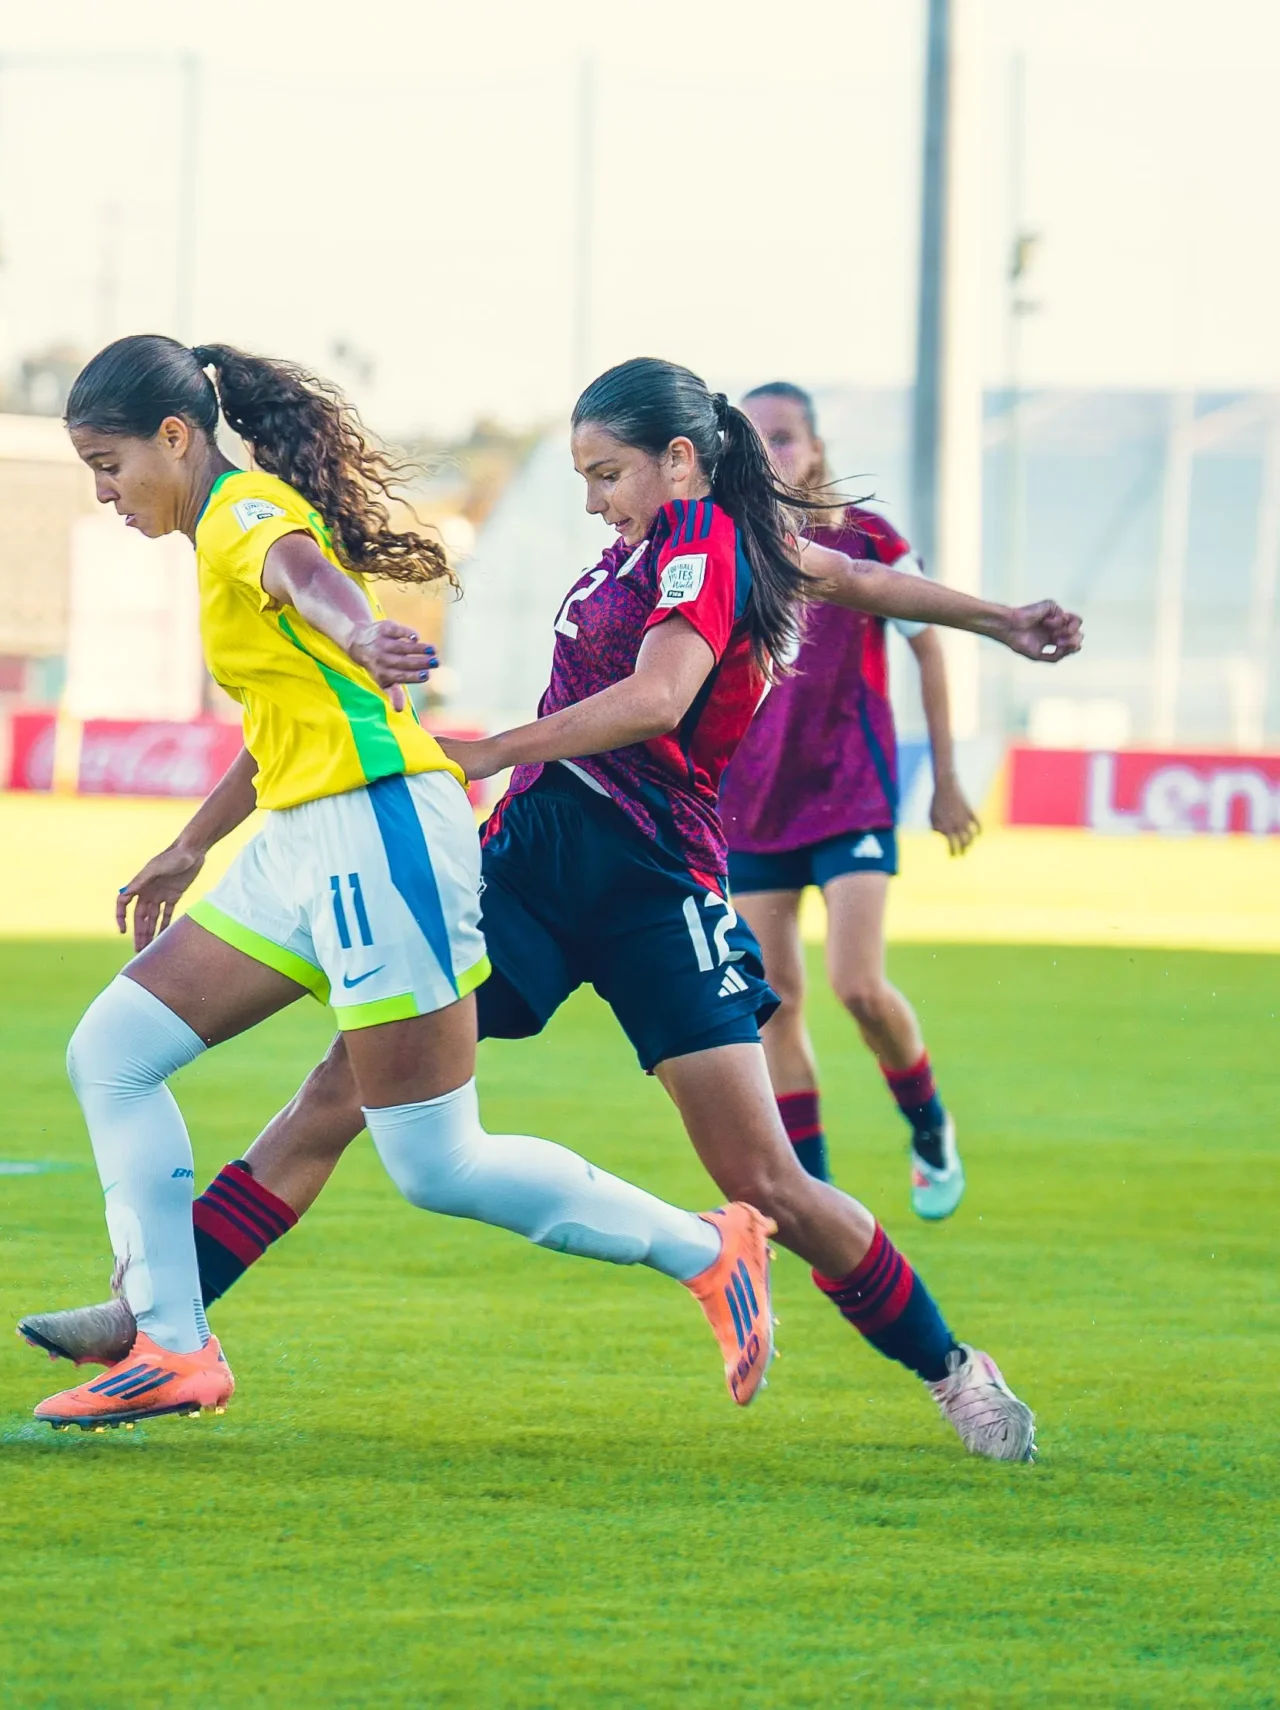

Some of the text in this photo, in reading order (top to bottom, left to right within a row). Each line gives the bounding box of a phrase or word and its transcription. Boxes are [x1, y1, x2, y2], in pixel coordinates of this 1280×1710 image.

[1090, 752, 1280, 838] Len
[330, 872, 374, 949] 11
[682, 891, 746, 972] 12
